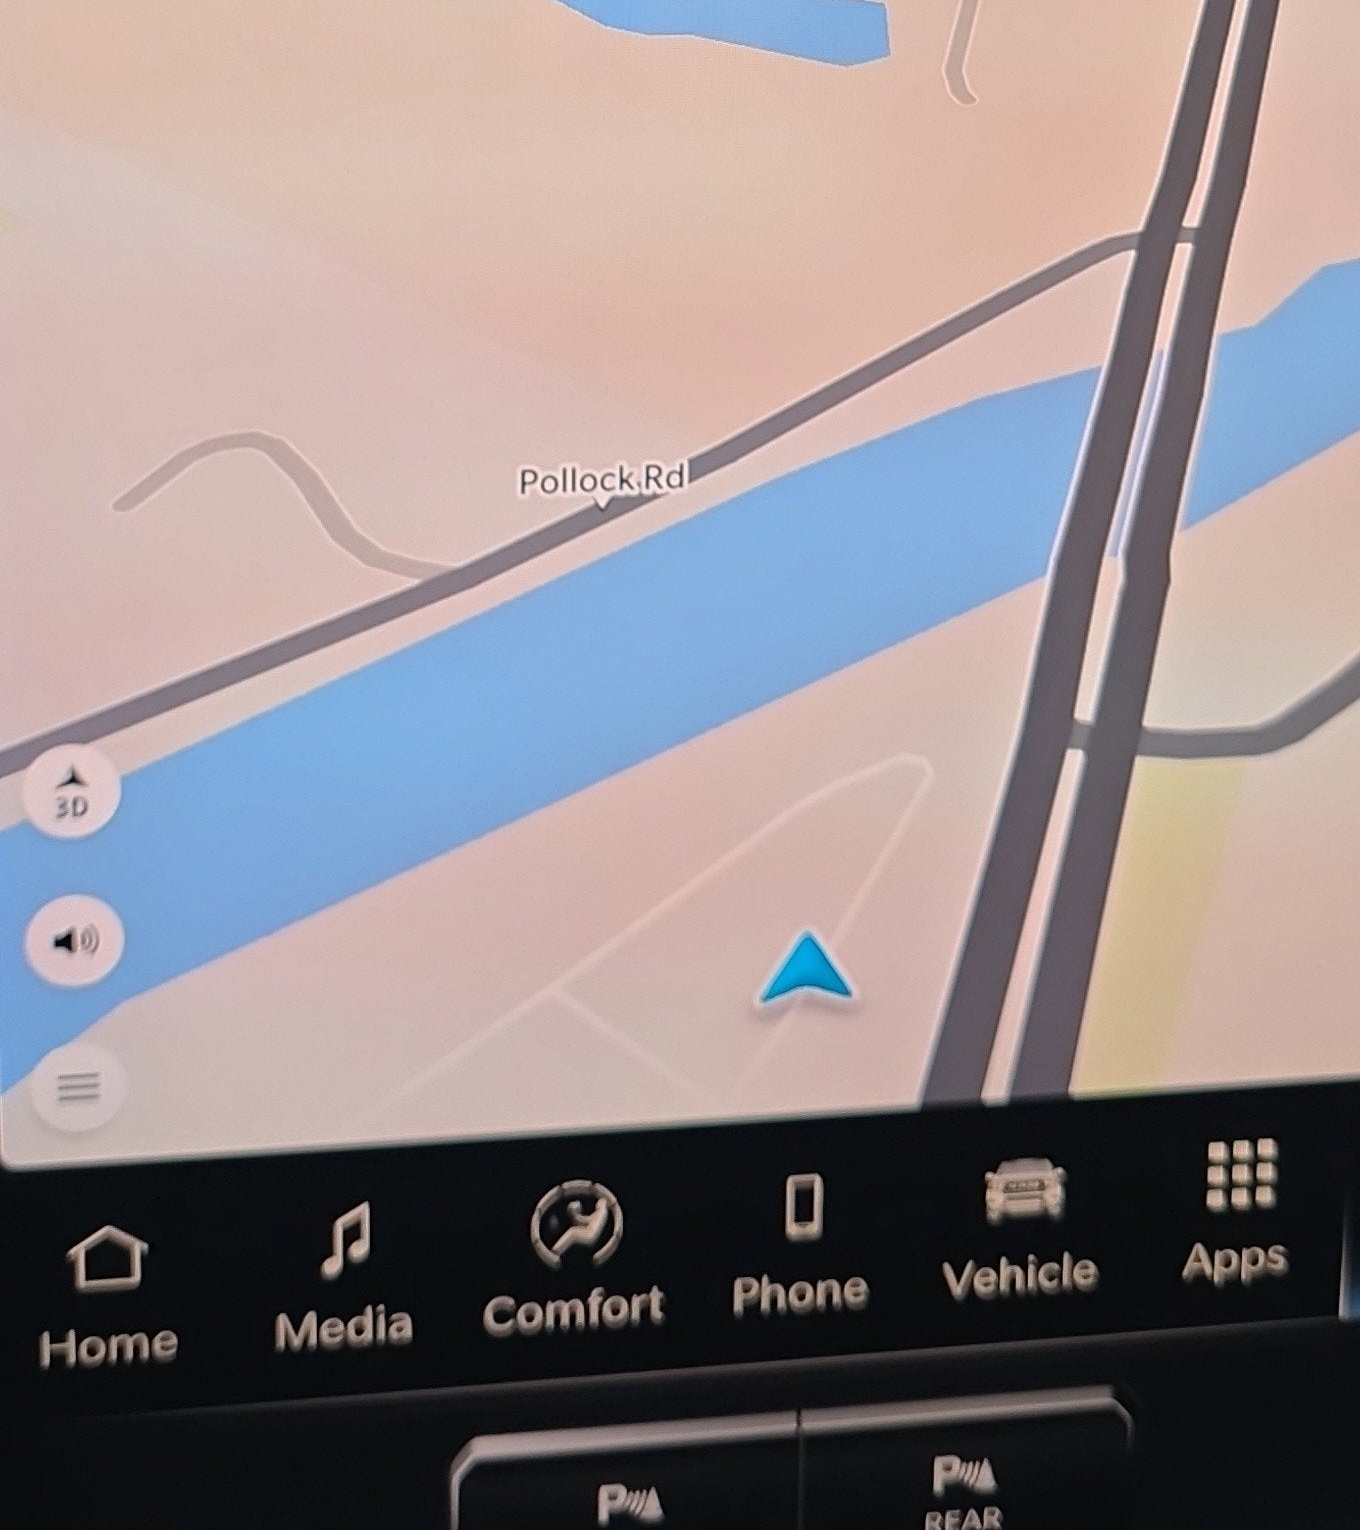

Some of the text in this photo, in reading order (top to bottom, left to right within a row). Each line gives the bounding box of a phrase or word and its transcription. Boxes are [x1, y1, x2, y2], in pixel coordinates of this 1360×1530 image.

[520, 463, 684, 494] Pollock Rd
[56, 796, 88, 819] 3D
[943, 1251, 1099, 1301] Vehicle
[1181, 1239, 1289, 1289] Apps
[483, 1284, 666, 1338] Comfort
[733, 1274, 869, 1317] Phone
[40, 1327, 178, 1370] Home
[274, 1304, 413, 1353] Media
